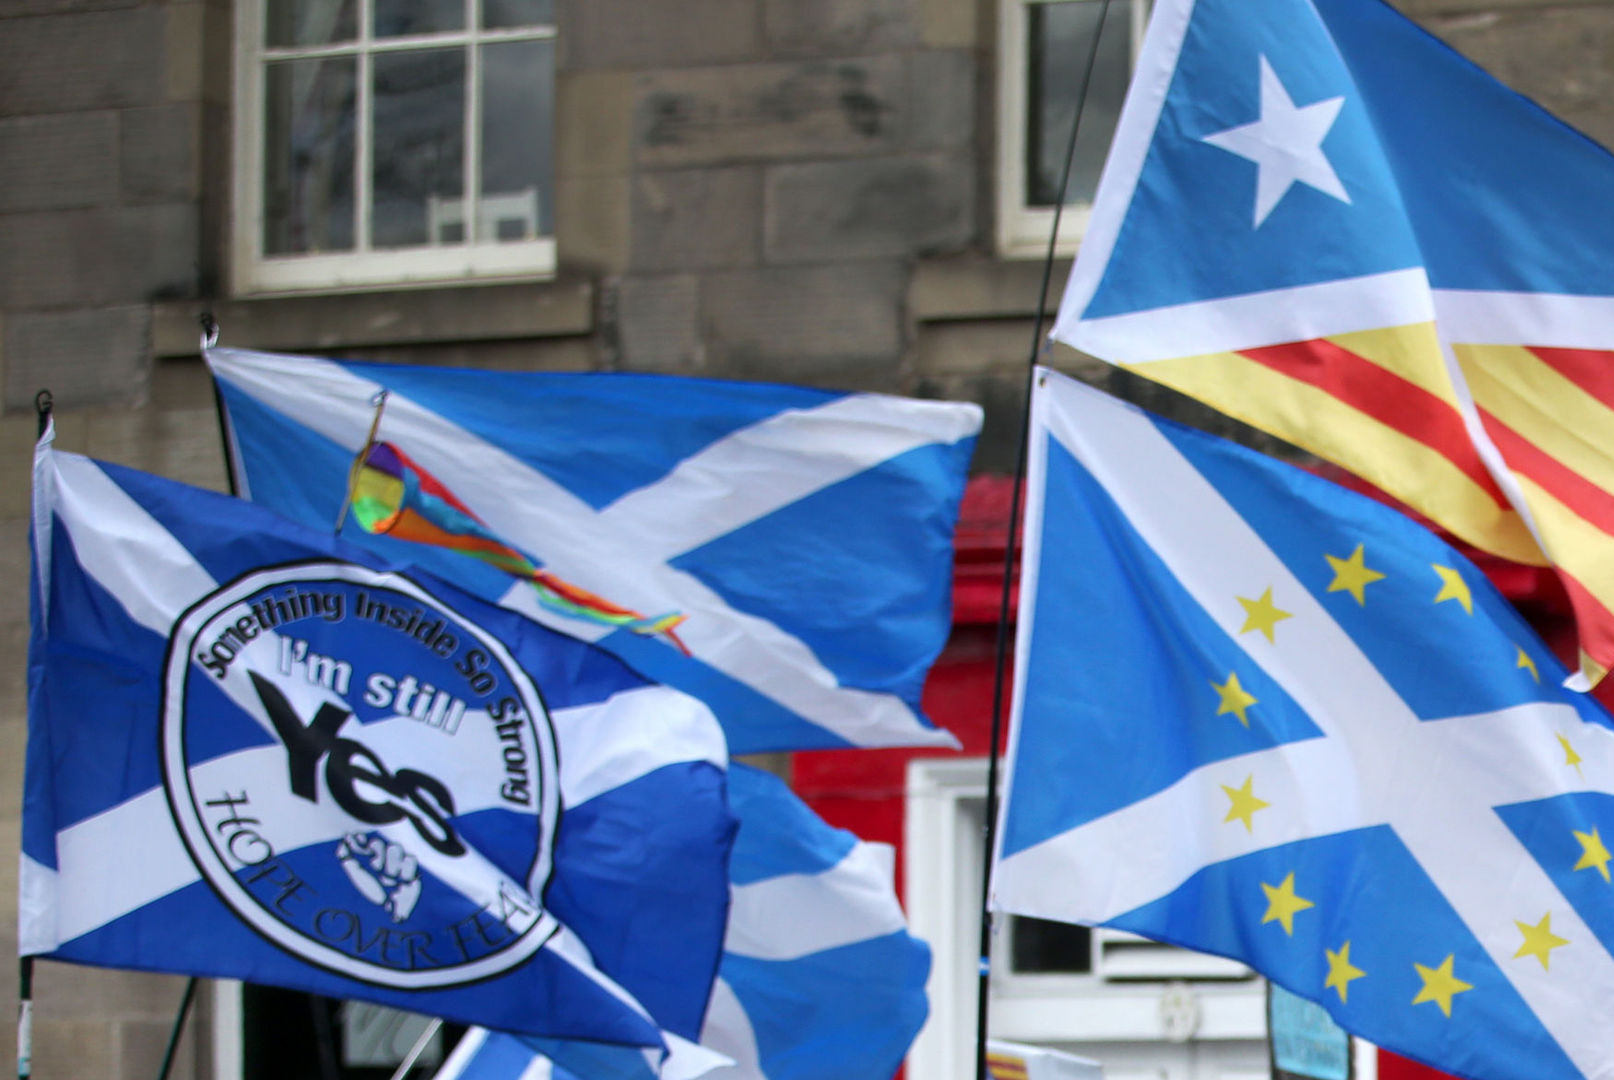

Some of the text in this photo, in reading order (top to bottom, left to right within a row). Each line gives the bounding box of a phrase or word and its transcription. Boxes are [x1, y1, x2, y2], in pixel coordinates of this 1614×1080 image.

[198, 587, 531, 807] Something Inside So Strong
[246, 668, 467, 858] Yes
[279, 634, 467, 736] I'm still
[205, 789, 532, 971] HOPE OVER FEA
